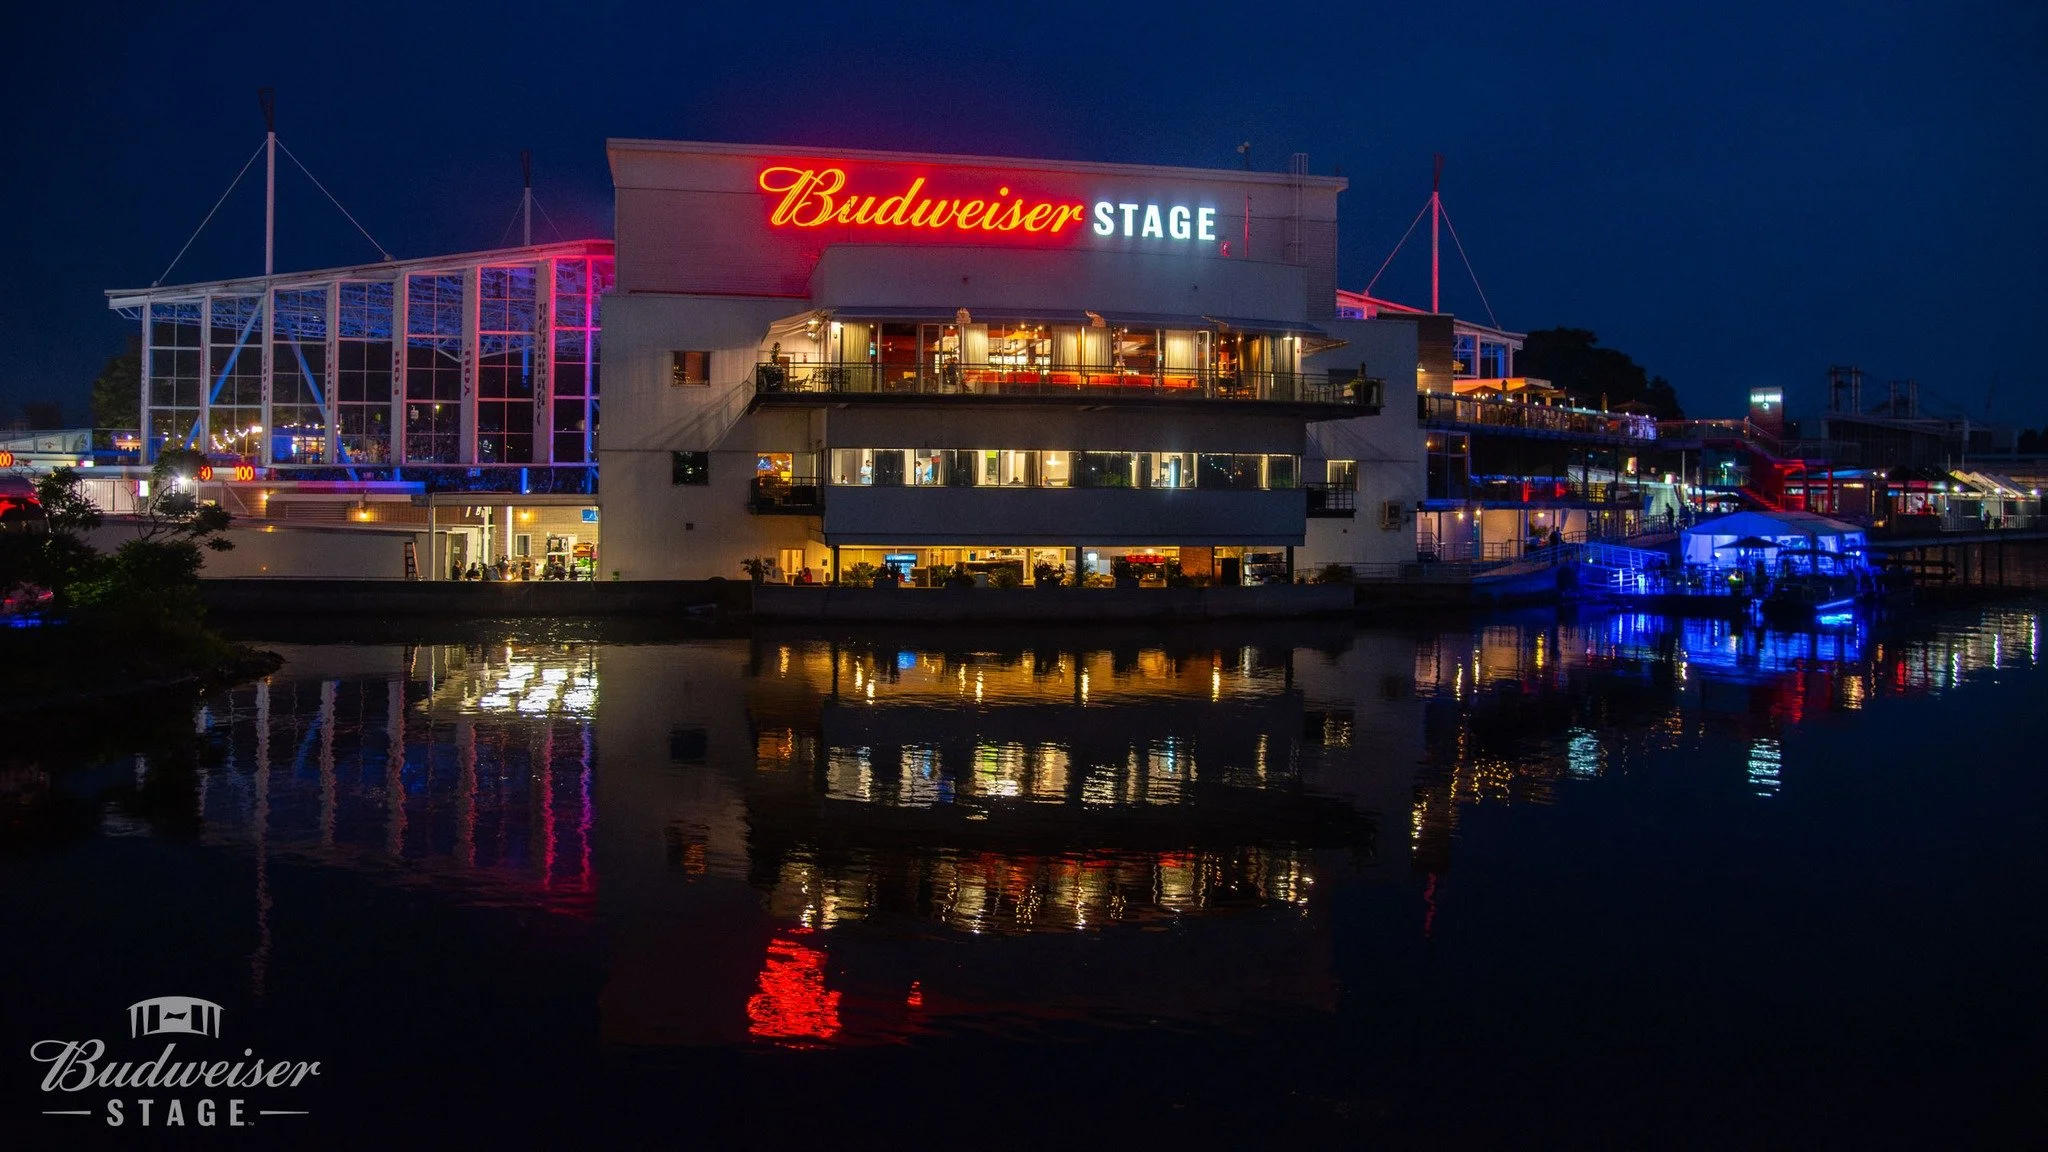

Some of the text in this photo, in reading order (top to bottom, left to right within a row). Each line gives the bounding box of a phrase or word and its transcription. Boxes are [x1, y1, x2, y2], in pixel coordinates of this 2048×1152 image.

[759, 166, 1216, 241] Budweiser STAGE
[235, 466, 253, 480] 100
